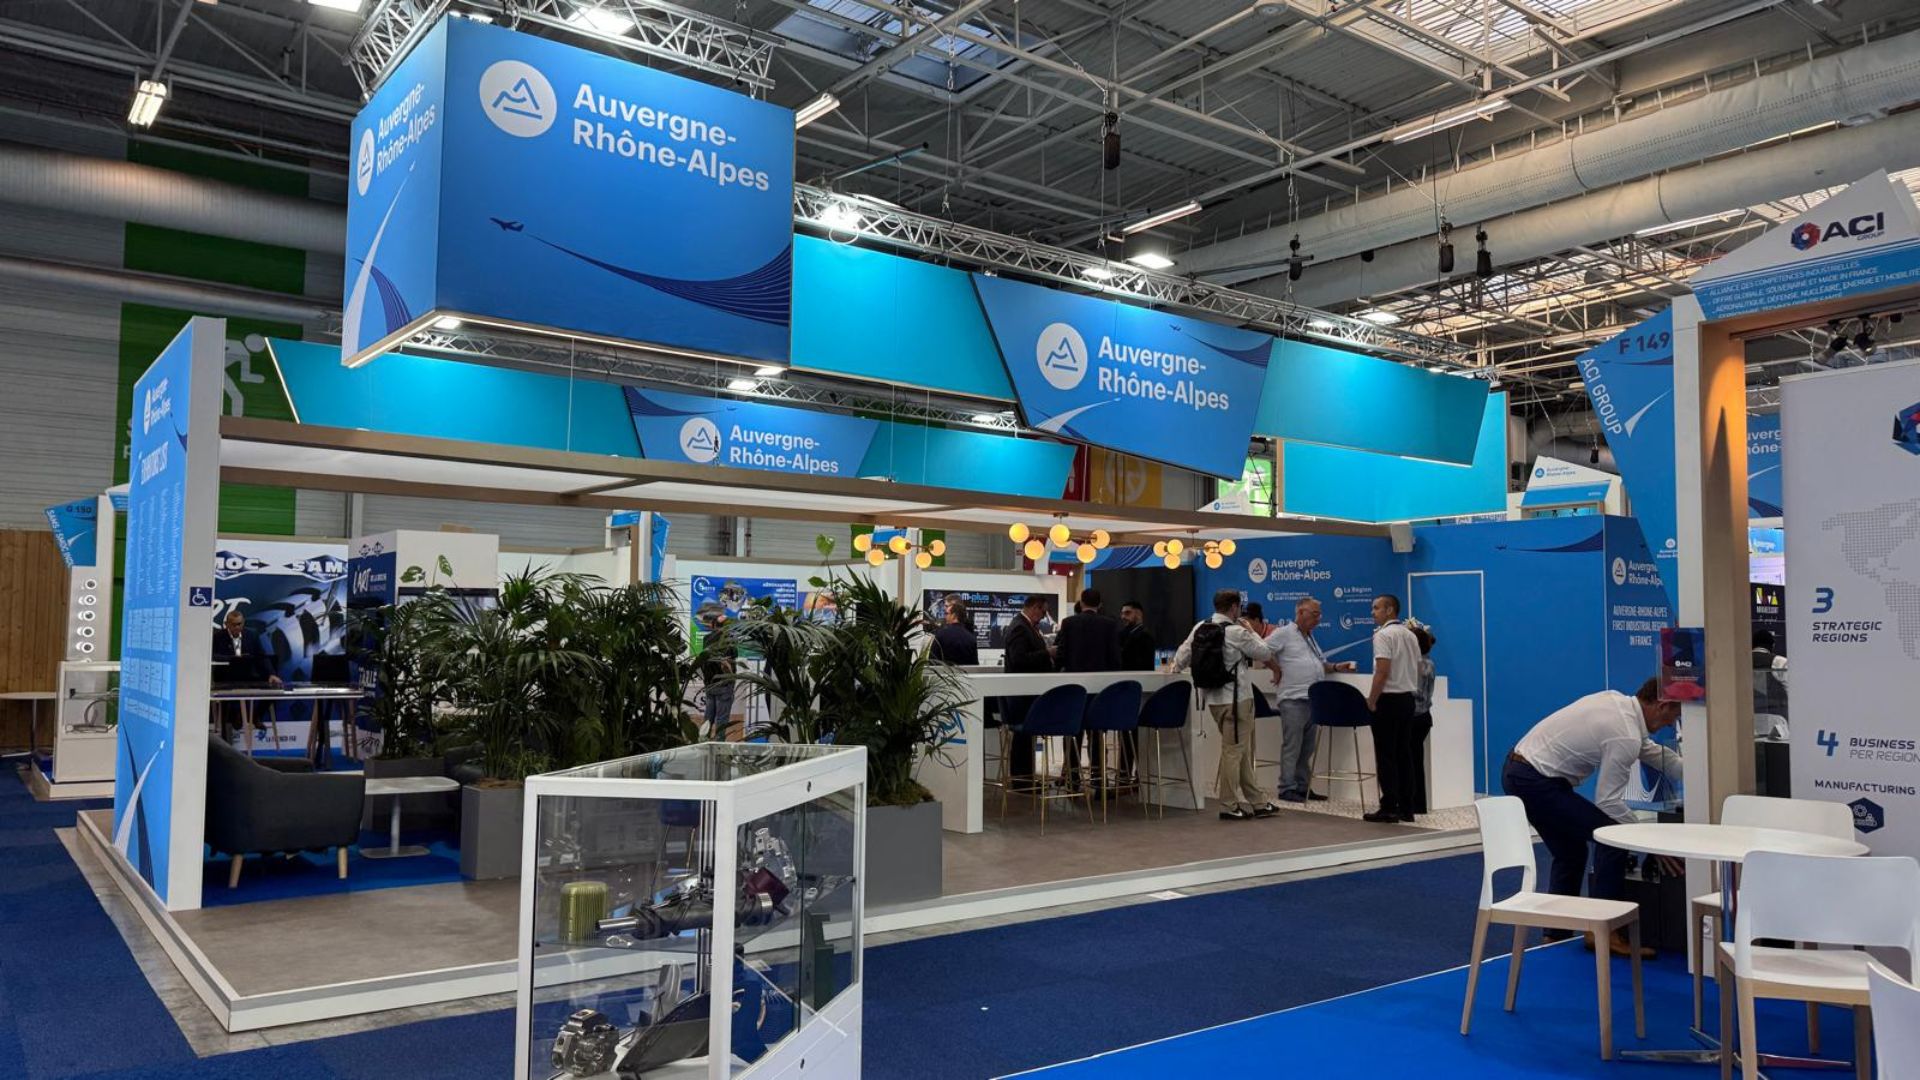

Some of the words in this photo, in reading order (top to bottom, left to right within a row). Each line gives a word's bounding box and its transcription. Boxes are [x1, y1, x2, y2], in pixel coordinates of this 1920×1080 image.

[378, 83, 424, 143] Auvergne-
[573, 83, 737, 143] Auvergne-
[377, 104, 435, 176] Rhône-Alpes
[573, 118, 769, 191] Rhône-Alpes
[1821, 212, 1884, 242] ACI
[1098, 336, 1207, 376] Auvergne-
[1619, 338, 1631, 354] F
[1637, 331, 1670, 352] 149
[1098, 366, 1230, 411] Rhône-Alpes
[1581, 358, 1601, 383] ACI
[1592, 384, 1622, 434] GROUP
[729, 424, 820, 451] Auvergne-
[730, 446, 839, 474] Rhône-Alpes
[1271, 558, 1319, 570] Auvergne-
[1271, 569, 1331, 582] Rhône-Alpes
[1812, 587, 1834, 613] 3
[1812, 621, 1883, 631] STRATEGIC
[1812, 633, 1868, 642] REGIONS
[1817, 729, 1839, 757] 4
[1849, 737, 1916, 750] BUSINESS
[1849, 749, 1874, 760] PER
[1815, 779, 1916, 795] MANUFACTURING
